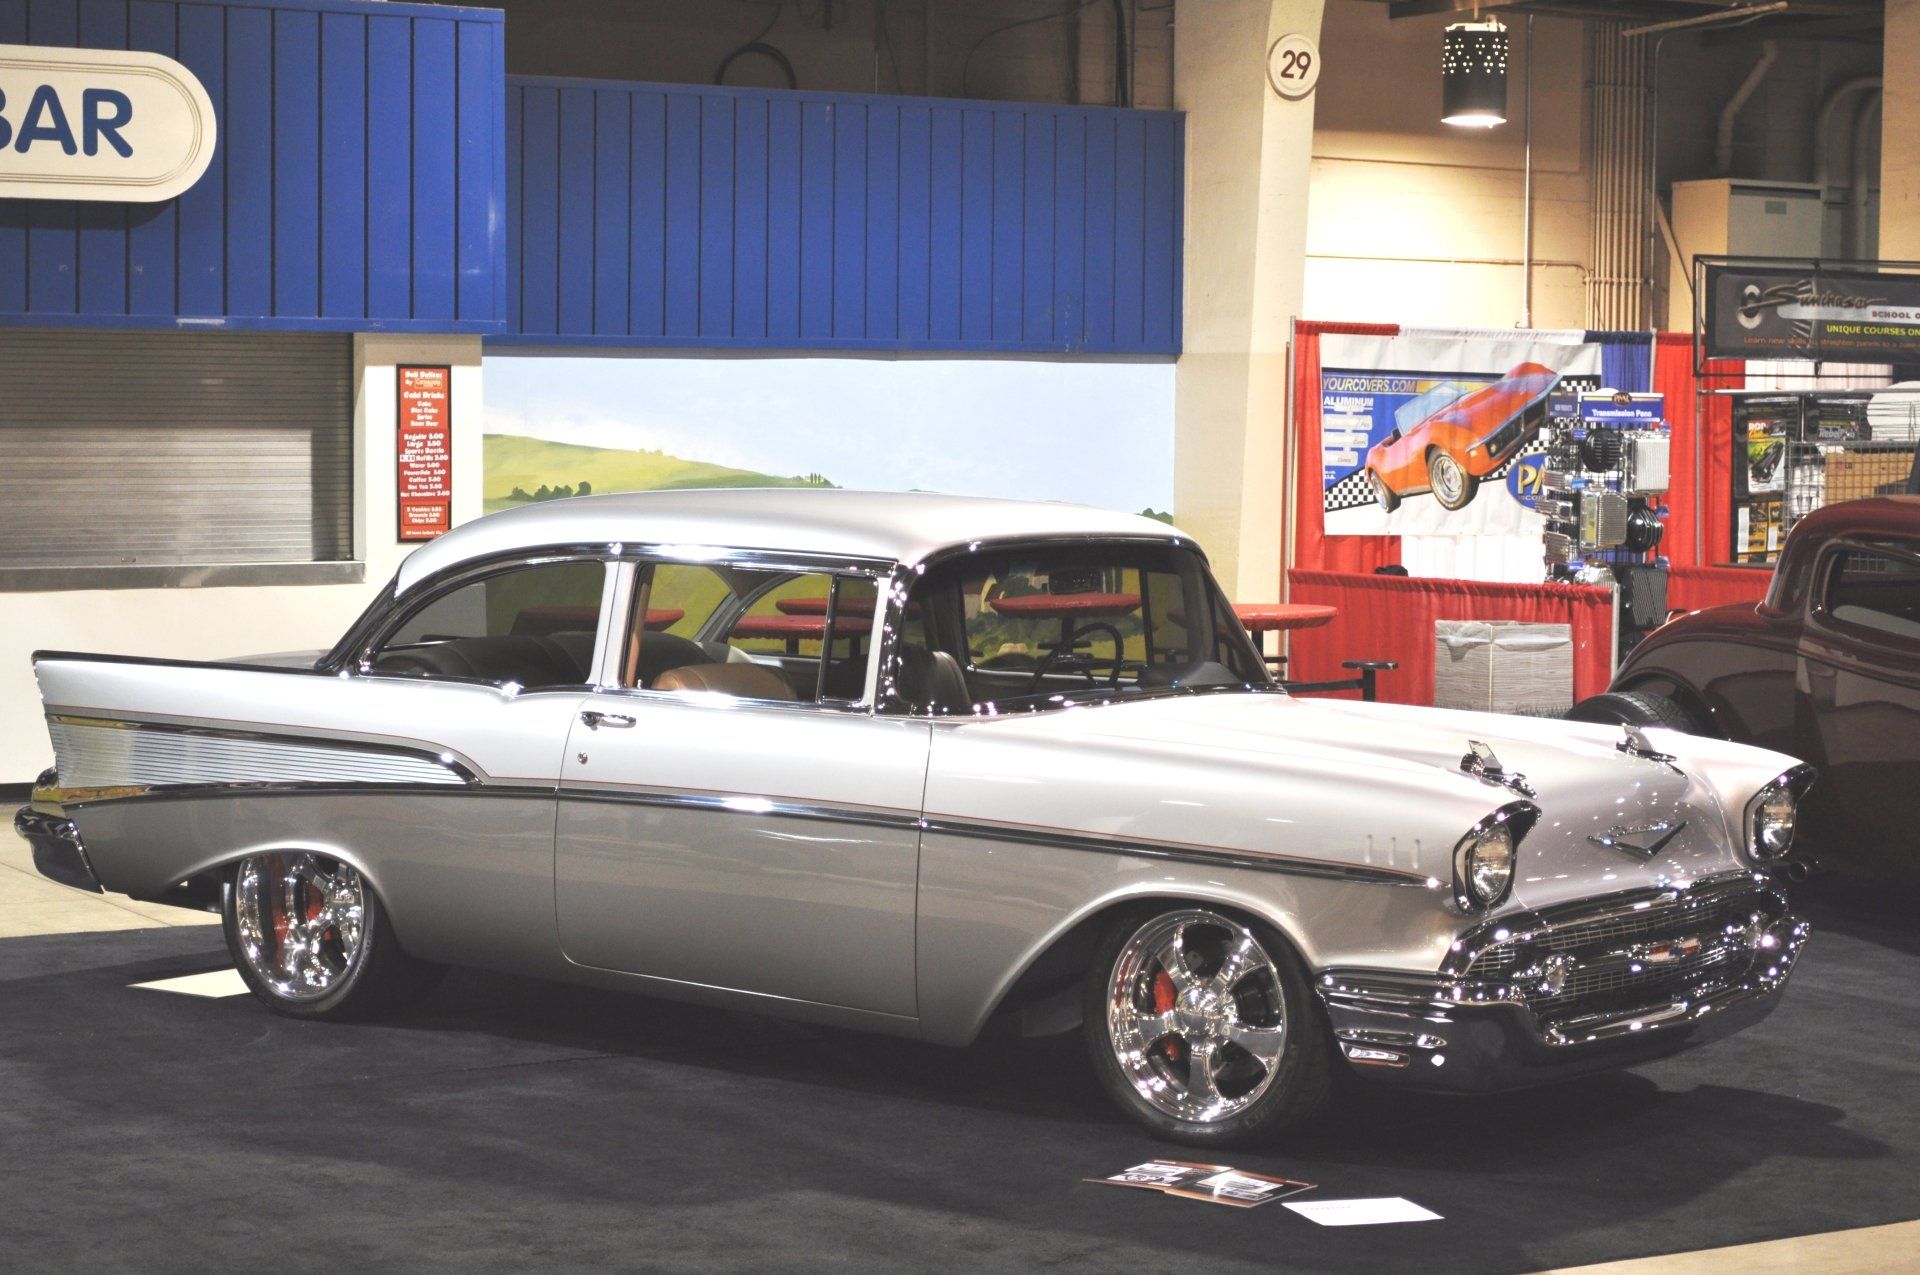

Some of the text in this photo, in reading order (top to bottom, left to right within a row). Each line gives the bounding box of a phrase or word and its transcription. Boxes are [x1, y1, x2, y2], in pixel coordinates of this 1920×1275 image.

[1280, 50, 1311, 79] 29
[0, 84, 133, 158] AR
[1871, 311, 1911, 319] SCHOOL
[1826, 325, 1860, 335] UNIQUE
[1863, 326, 1905, 336] COURSES
[1323, 377, 1416, 393] YOURCOVERS.COM
[404, 391, 445, 399] Cold Drinks
[1323, 396, 1373, 408] ALUMINUM
[1592, 409, 1652, 417] Transmission Pans
